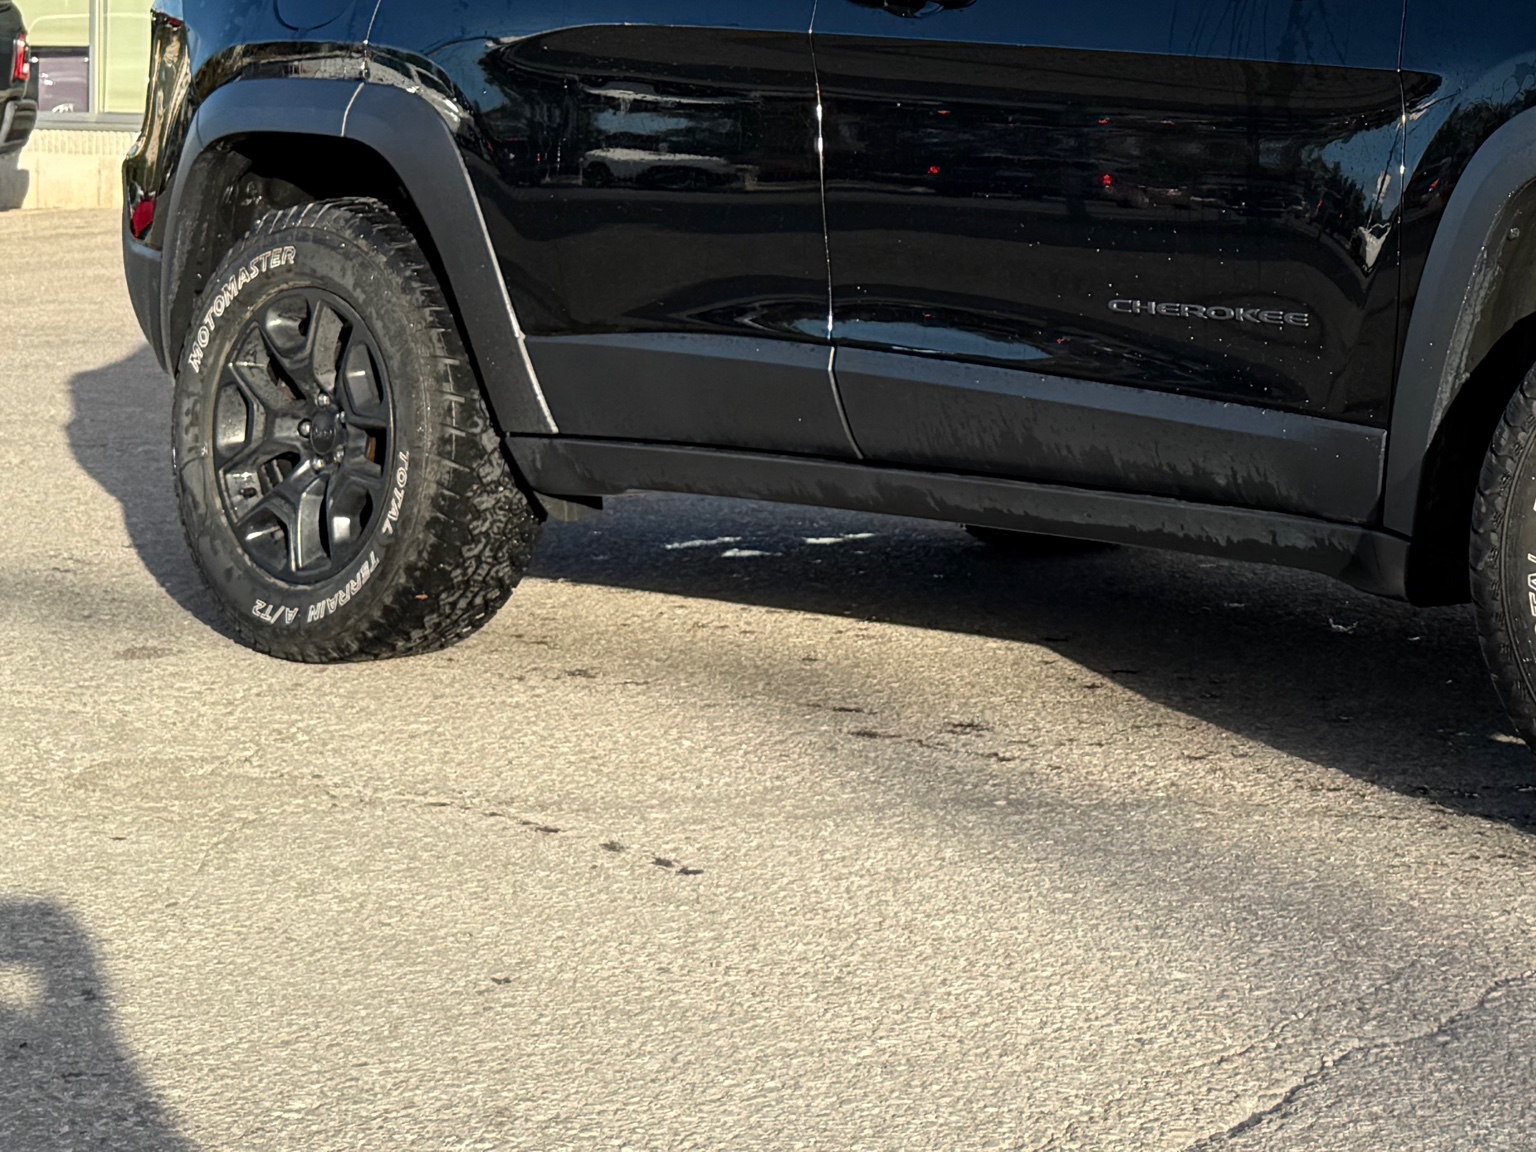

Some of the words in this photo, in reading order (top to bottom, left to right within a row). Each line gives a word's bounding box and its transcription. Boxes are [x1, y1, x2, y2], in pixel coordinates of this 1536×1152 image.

[188, 245, 296, 374] MOTOMASTER
[1107, 299, 1310, 328] CHEROKEE
[381, 450, 411, 535] TOTAL
[251, 598, 300, 625] A/T2
[306, 550, 381, 623] TERRAIN
